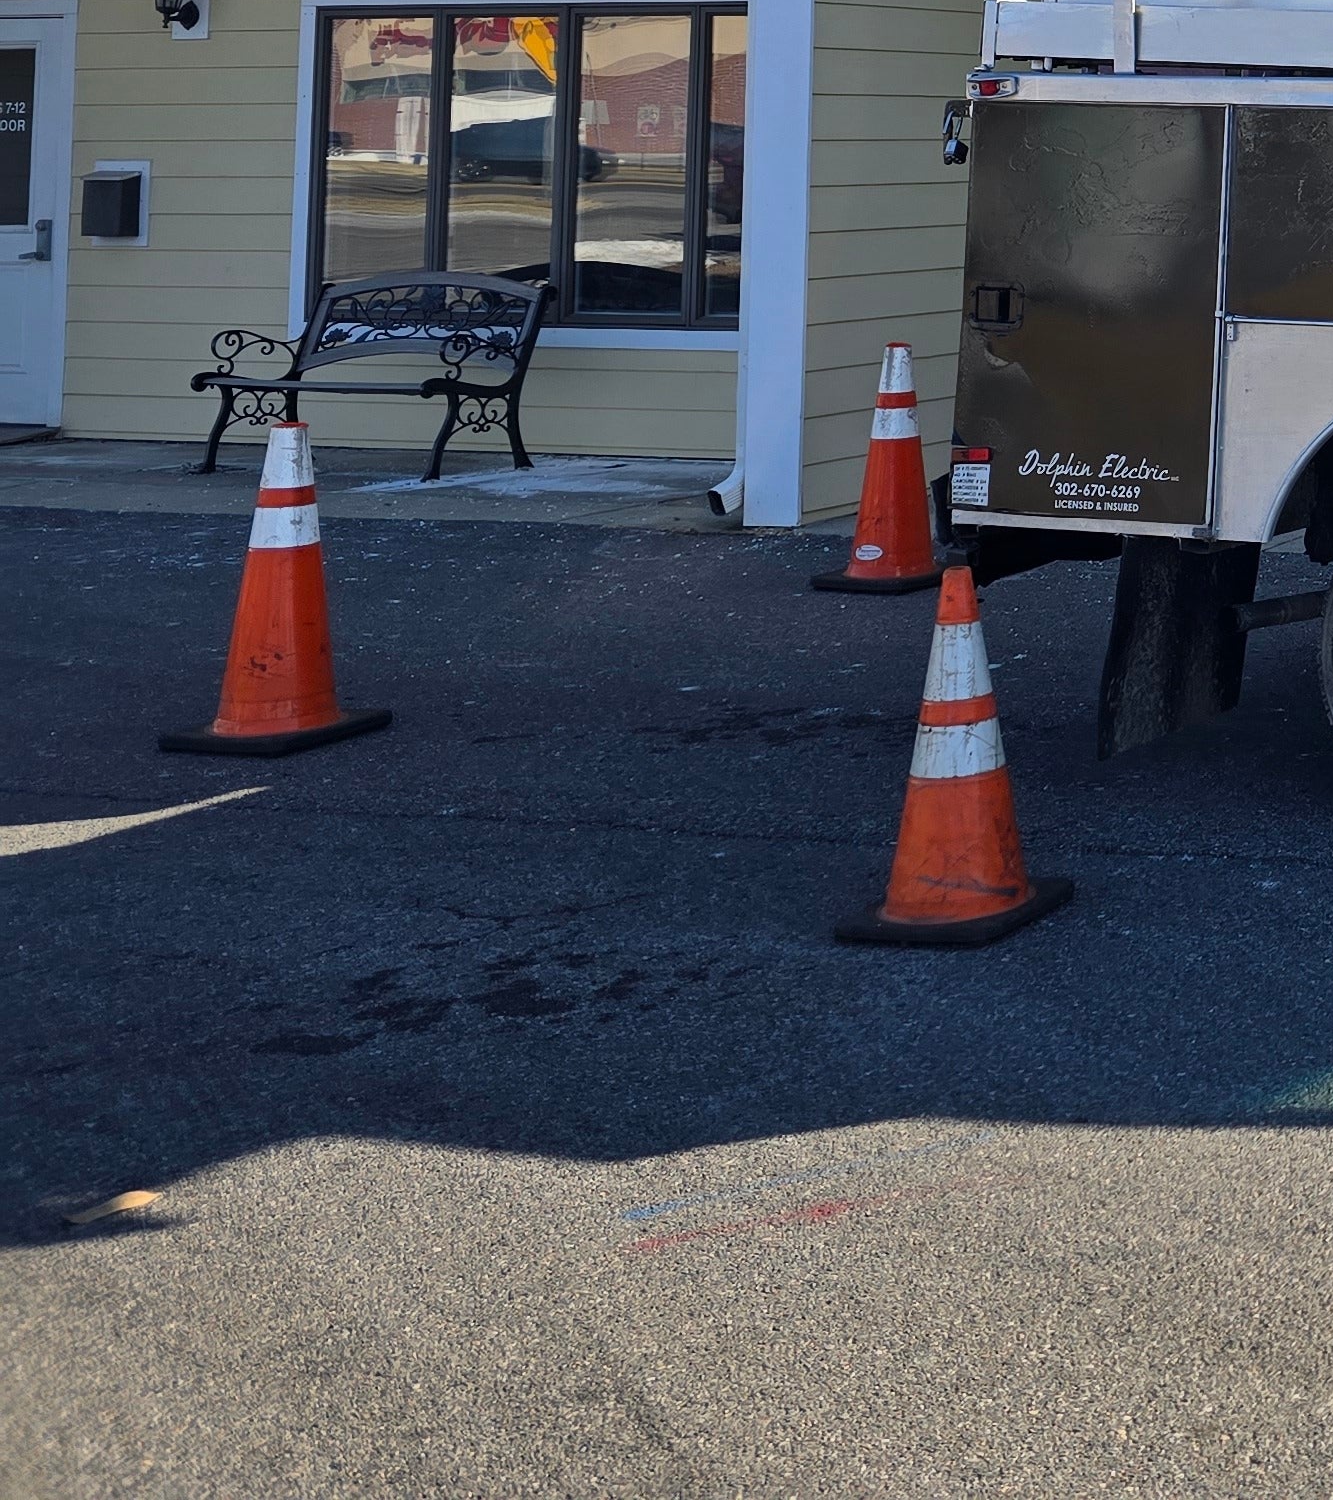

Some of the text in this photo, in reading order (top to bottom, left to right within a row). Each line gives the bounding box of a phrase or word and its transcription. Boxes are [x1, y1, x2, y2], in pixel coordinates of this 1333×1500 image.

[5, 101, 26, 114] 7-12
[1018, 449, 1170, 487] Dolphin Electric
[1054, 482, 1141, 498] 302-670-6269
[1054, 499, 1139, 512] LICENSED & INSURED
